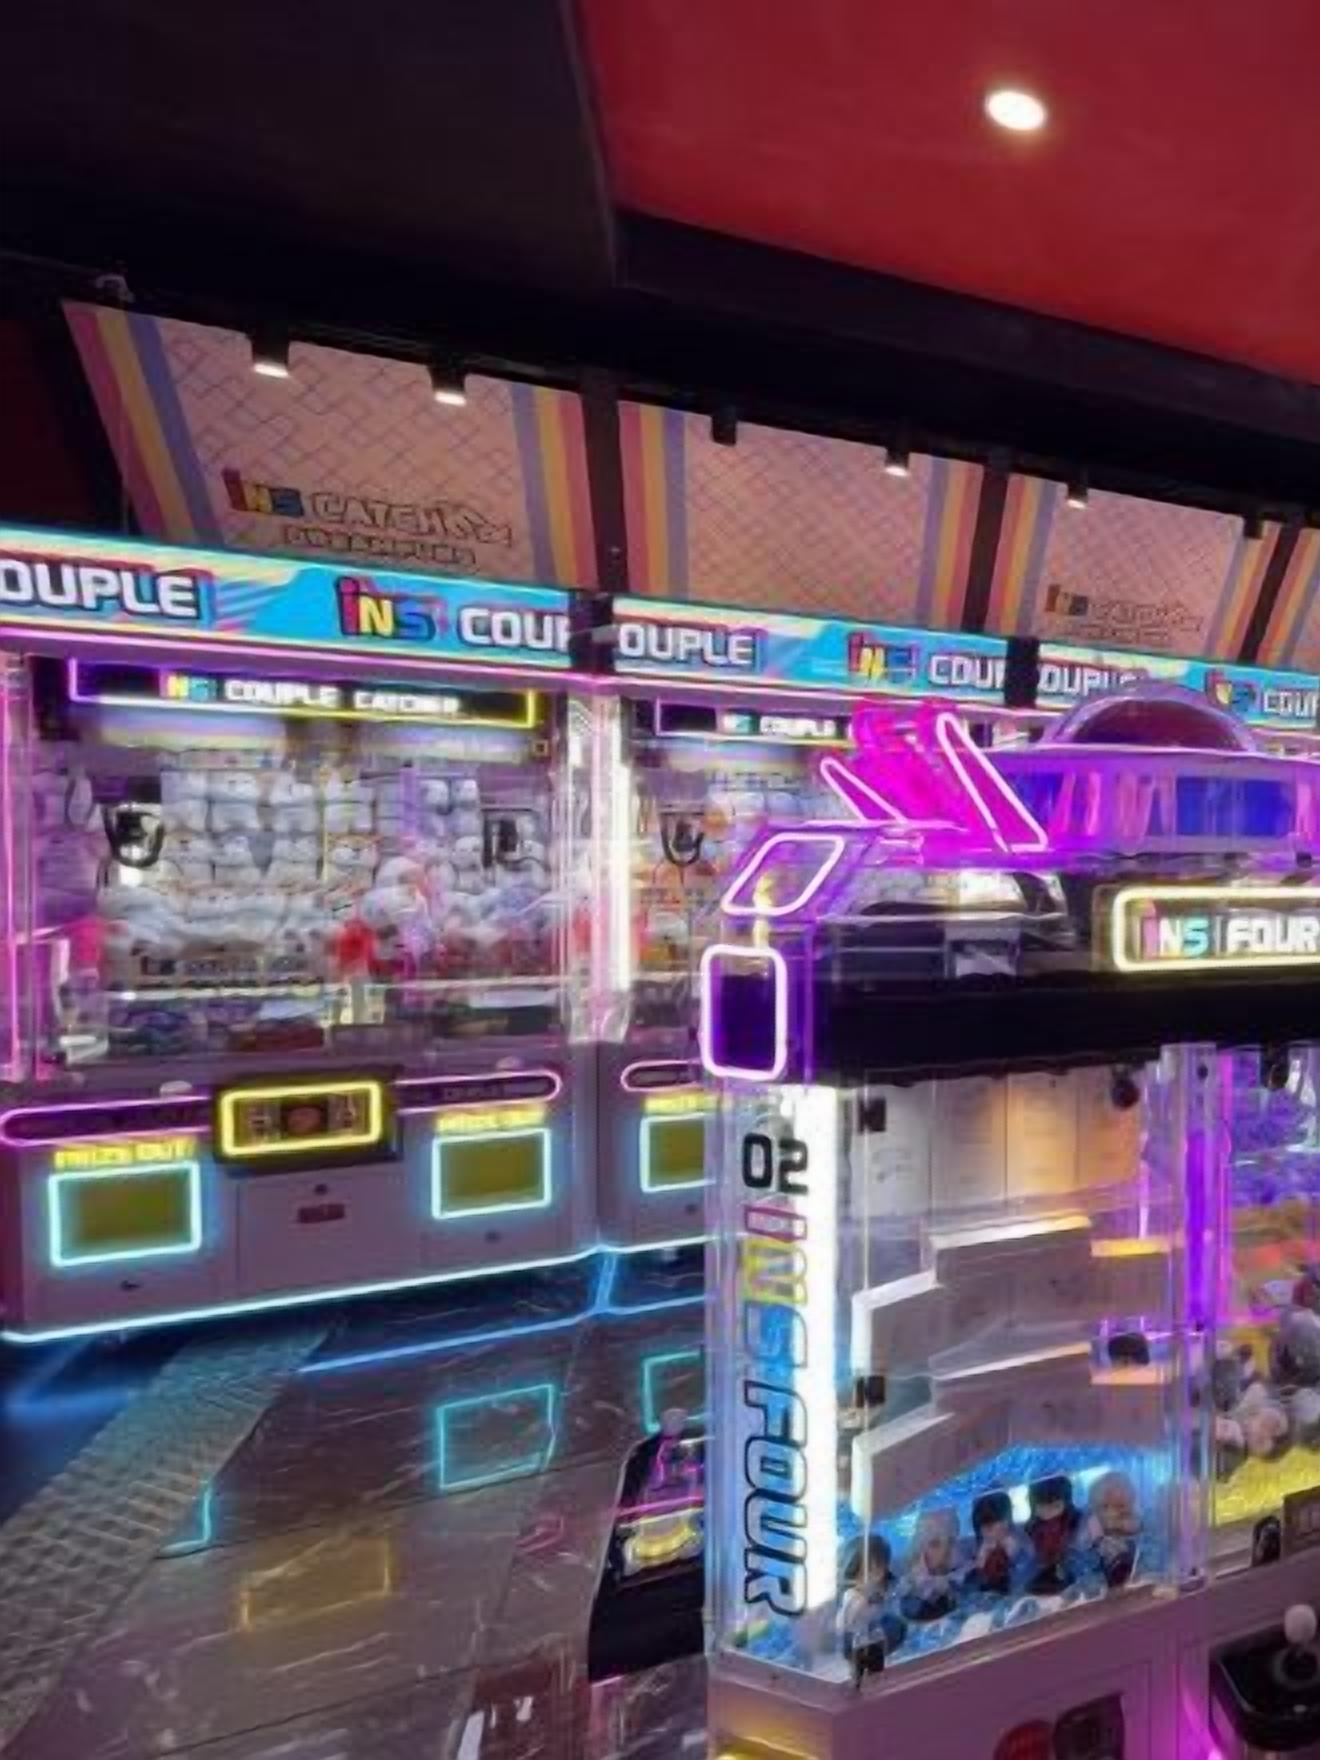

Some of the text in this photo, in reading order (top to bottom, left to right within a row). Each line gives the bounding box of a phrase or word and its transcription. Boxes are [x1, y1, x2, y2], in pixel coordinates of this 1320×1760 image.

[224, 677, 341, 708] COUPLE
[1226, 915, 1318, 954] FOUR
[742, 1133, 809, 1195] 02
[742, 1378, 809, 1618] FOUR
